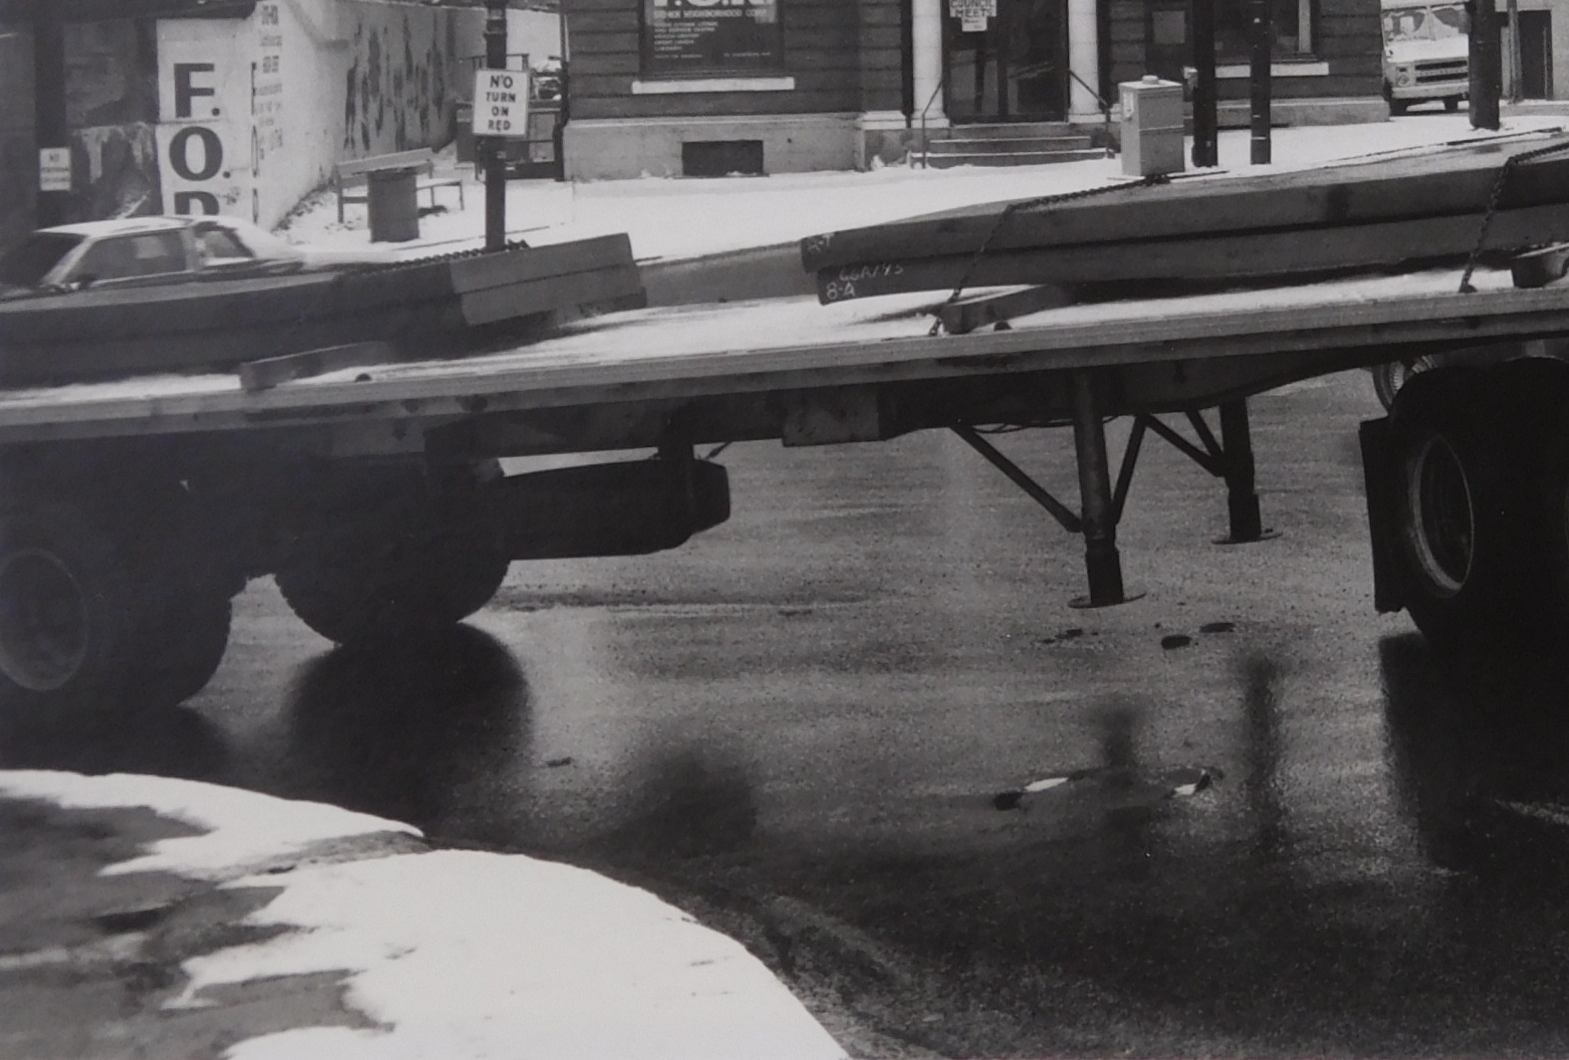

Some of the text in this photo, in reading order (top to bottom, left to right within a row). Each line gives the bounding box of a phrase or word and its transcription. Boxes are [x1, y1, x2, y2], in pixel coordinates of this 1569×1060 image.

[955, 8, 993, 18] MEETS
[490, 74, 514, 89] NO
[486, 91, 517, 103] TURN
[491, 106, 510, 117] ON
[487, 119, 512, 132] RED
